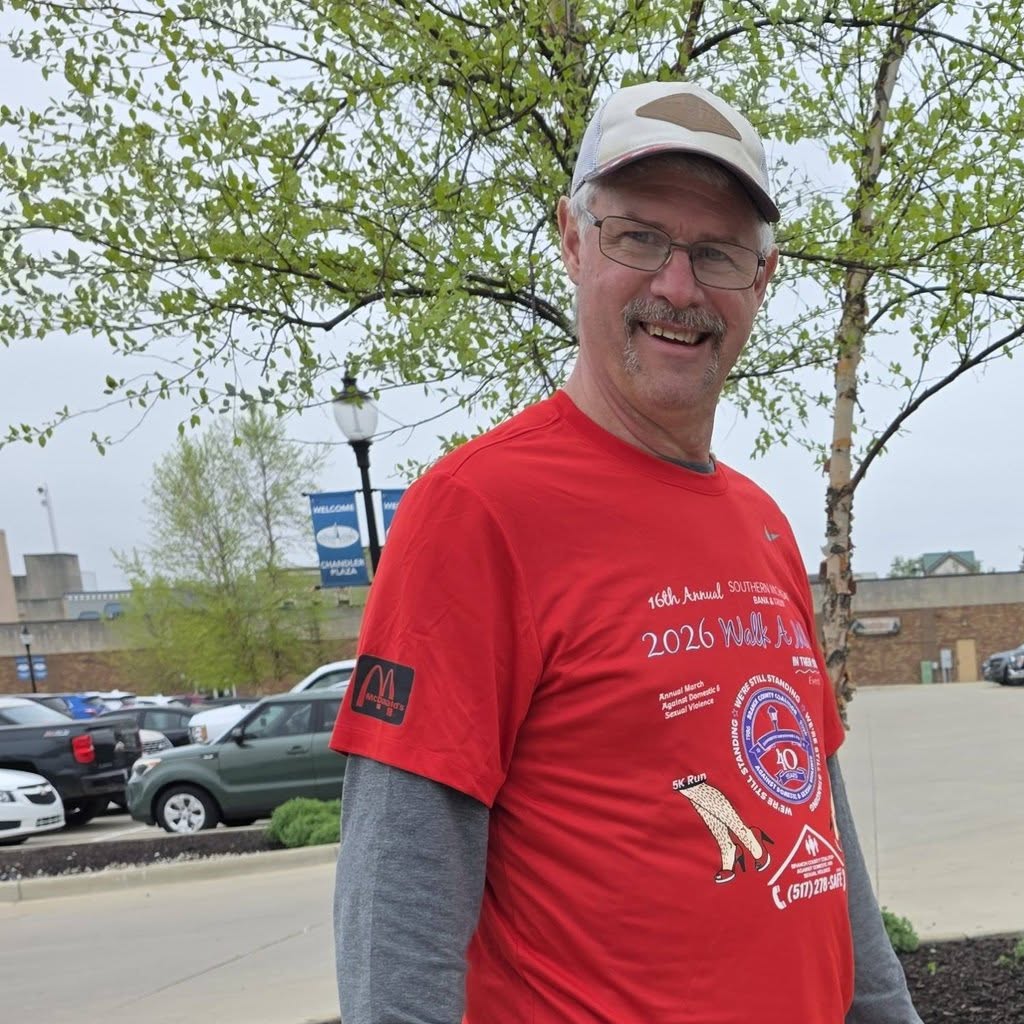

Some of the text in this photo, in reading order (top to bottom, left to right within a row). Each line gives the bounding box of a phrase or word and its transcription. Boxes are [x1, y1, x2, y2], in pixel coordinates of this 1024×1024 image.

[313, 503, 355, 514] WELCOME
[320, 559, 365, 570] CHANDLER
[330, 568, 357, 577] PLAZA
[648, 582, 724, 609] 16th Annual
[728, 581, 771, 594] SOUTHERN
[642, 617, 715, 657] 2026
[717, 611, 771, 649] Walk
[774, 615, 792, 649] A
[659, 680, 705, 701] Annual March
[662, 696, 688, 710] Against
[688, 687, 716, 701] Domestic
[748, 674, 767, 688] STILL
[766, 674, 801, 703] STANDING
[665, 698, 715, 719] Sexual Violence
[731, 719, 749, 776] STANDING
[775, 748, 798, 771] 40
[672, 773, 707, 790] 5K Run
[746, 775, 768, 801] STILL
[787, 880, 813, 904] (517)
